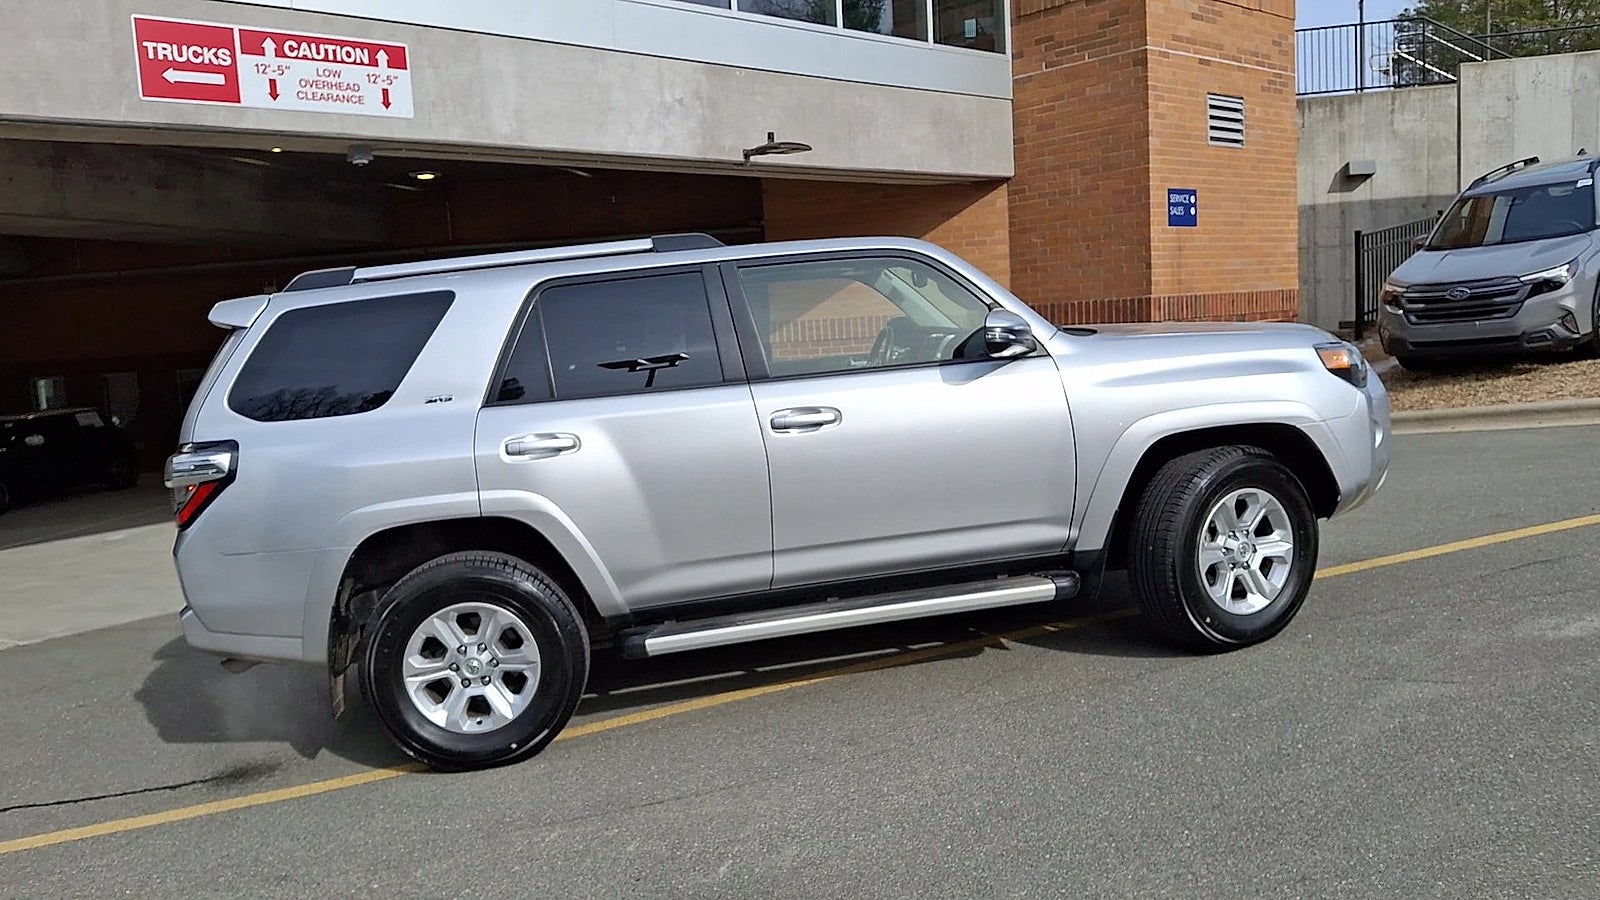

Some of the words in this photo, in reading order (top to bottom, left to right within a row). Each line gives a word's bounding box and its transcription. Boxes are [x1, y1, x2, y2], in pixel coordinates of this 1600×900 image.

[142, 41, 232, 66] TRUCKS
[283, 40, 369, 64] CAUTION
[316, 68, 341, 78] LOW
[298, 78, 360, 92] OVERHEAD
[296, 90, 365, 105] CLEARANCE
[1169, 193, 1189, 203] SERVICE
[1169, 206, 1184, 215] SALES
